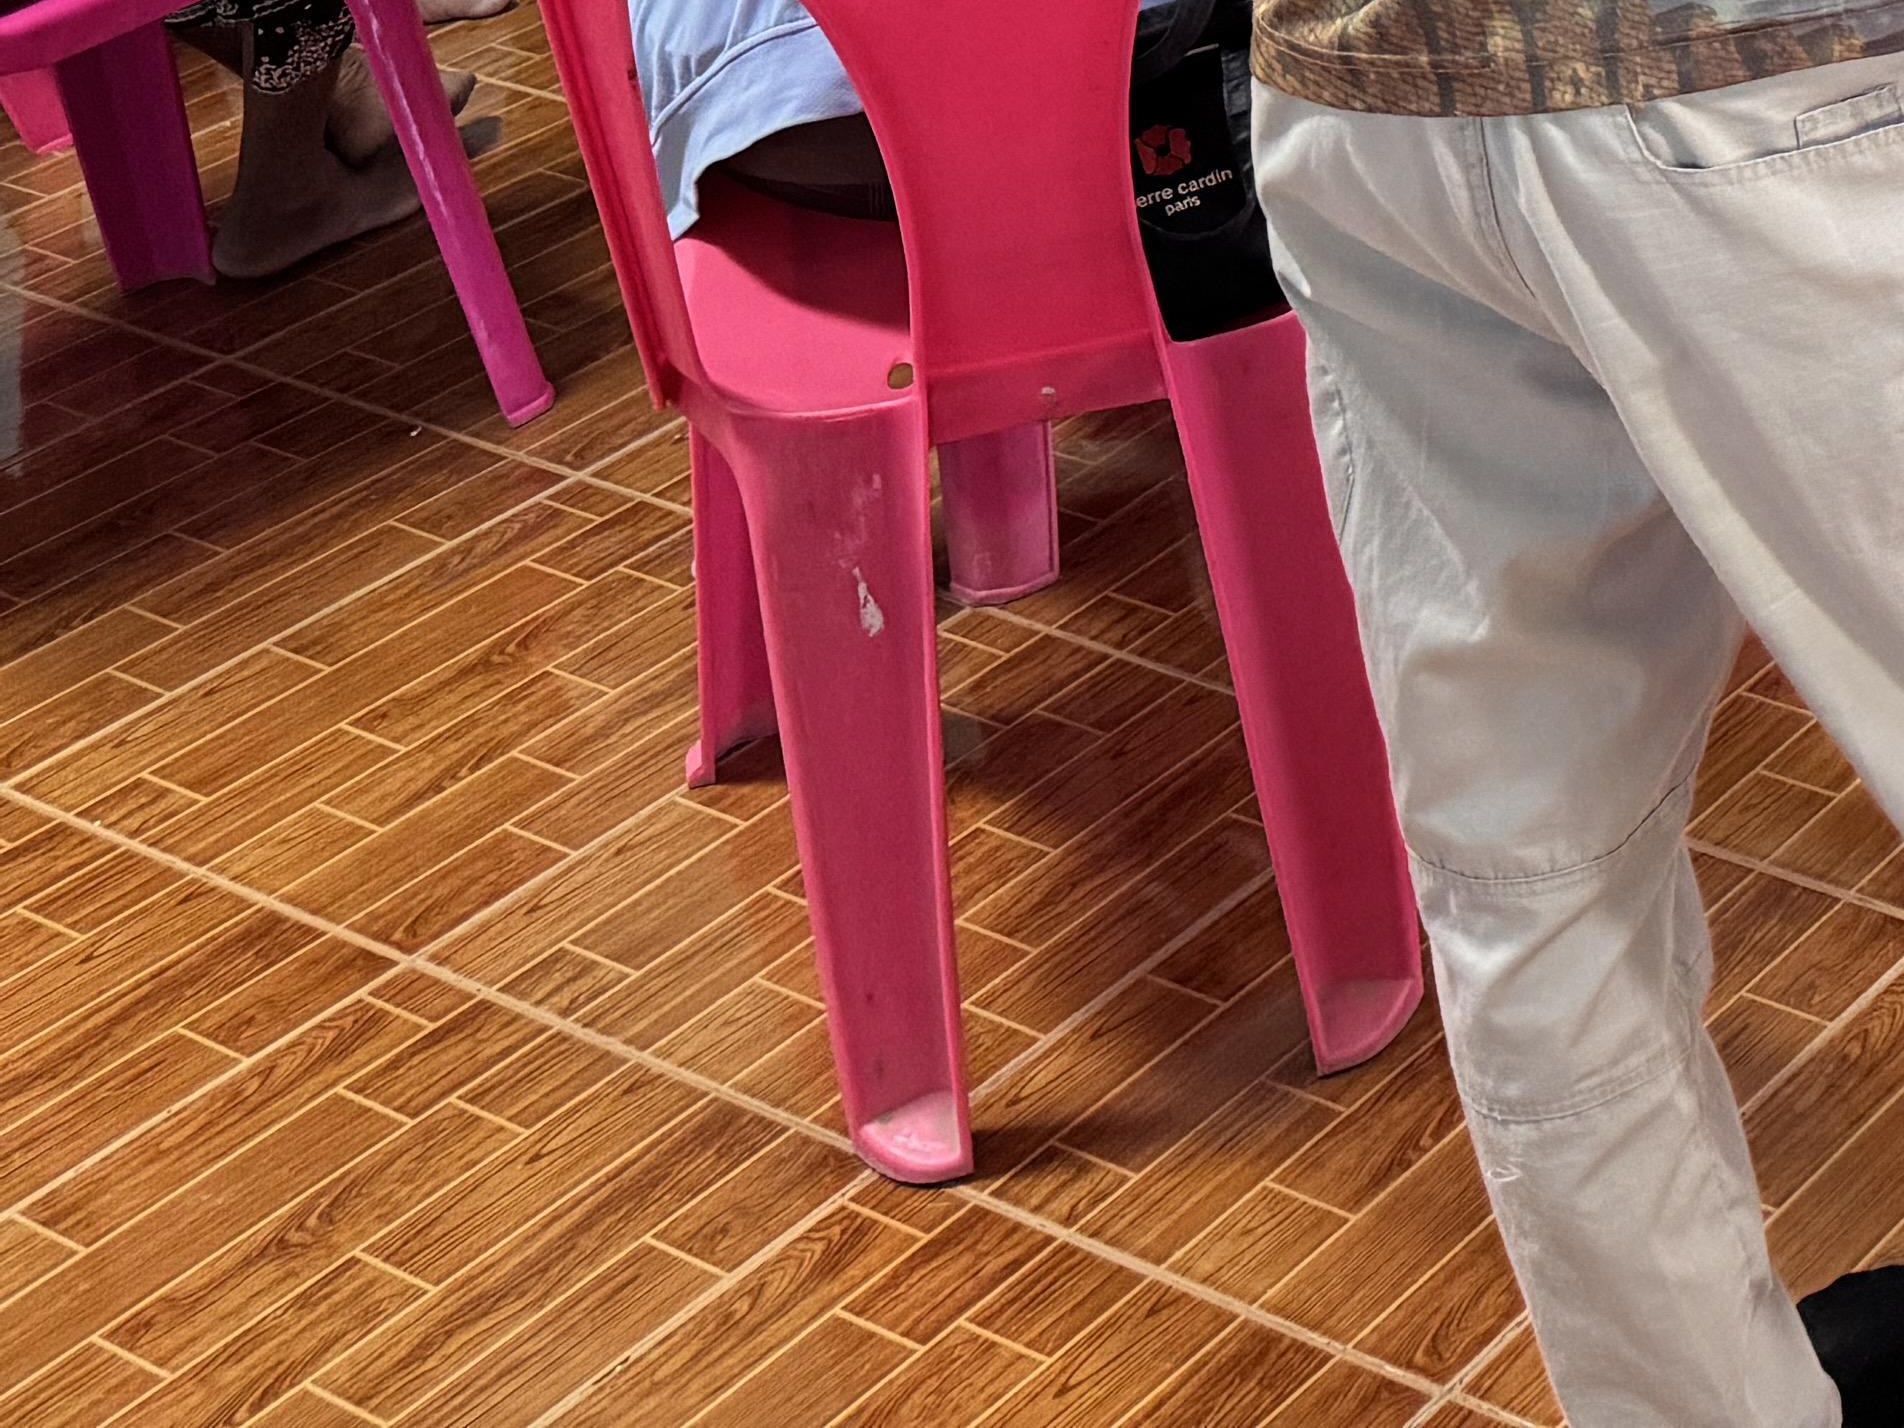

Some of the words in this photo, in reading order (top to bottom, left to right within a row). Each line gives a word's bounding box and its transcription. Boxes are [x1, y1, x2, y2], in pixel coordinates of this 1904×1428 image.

[1136, 187, 1174, 208] erre
[1177, 168, 1233, 195] cardin
[1164, 195, 1201, 217] paris
